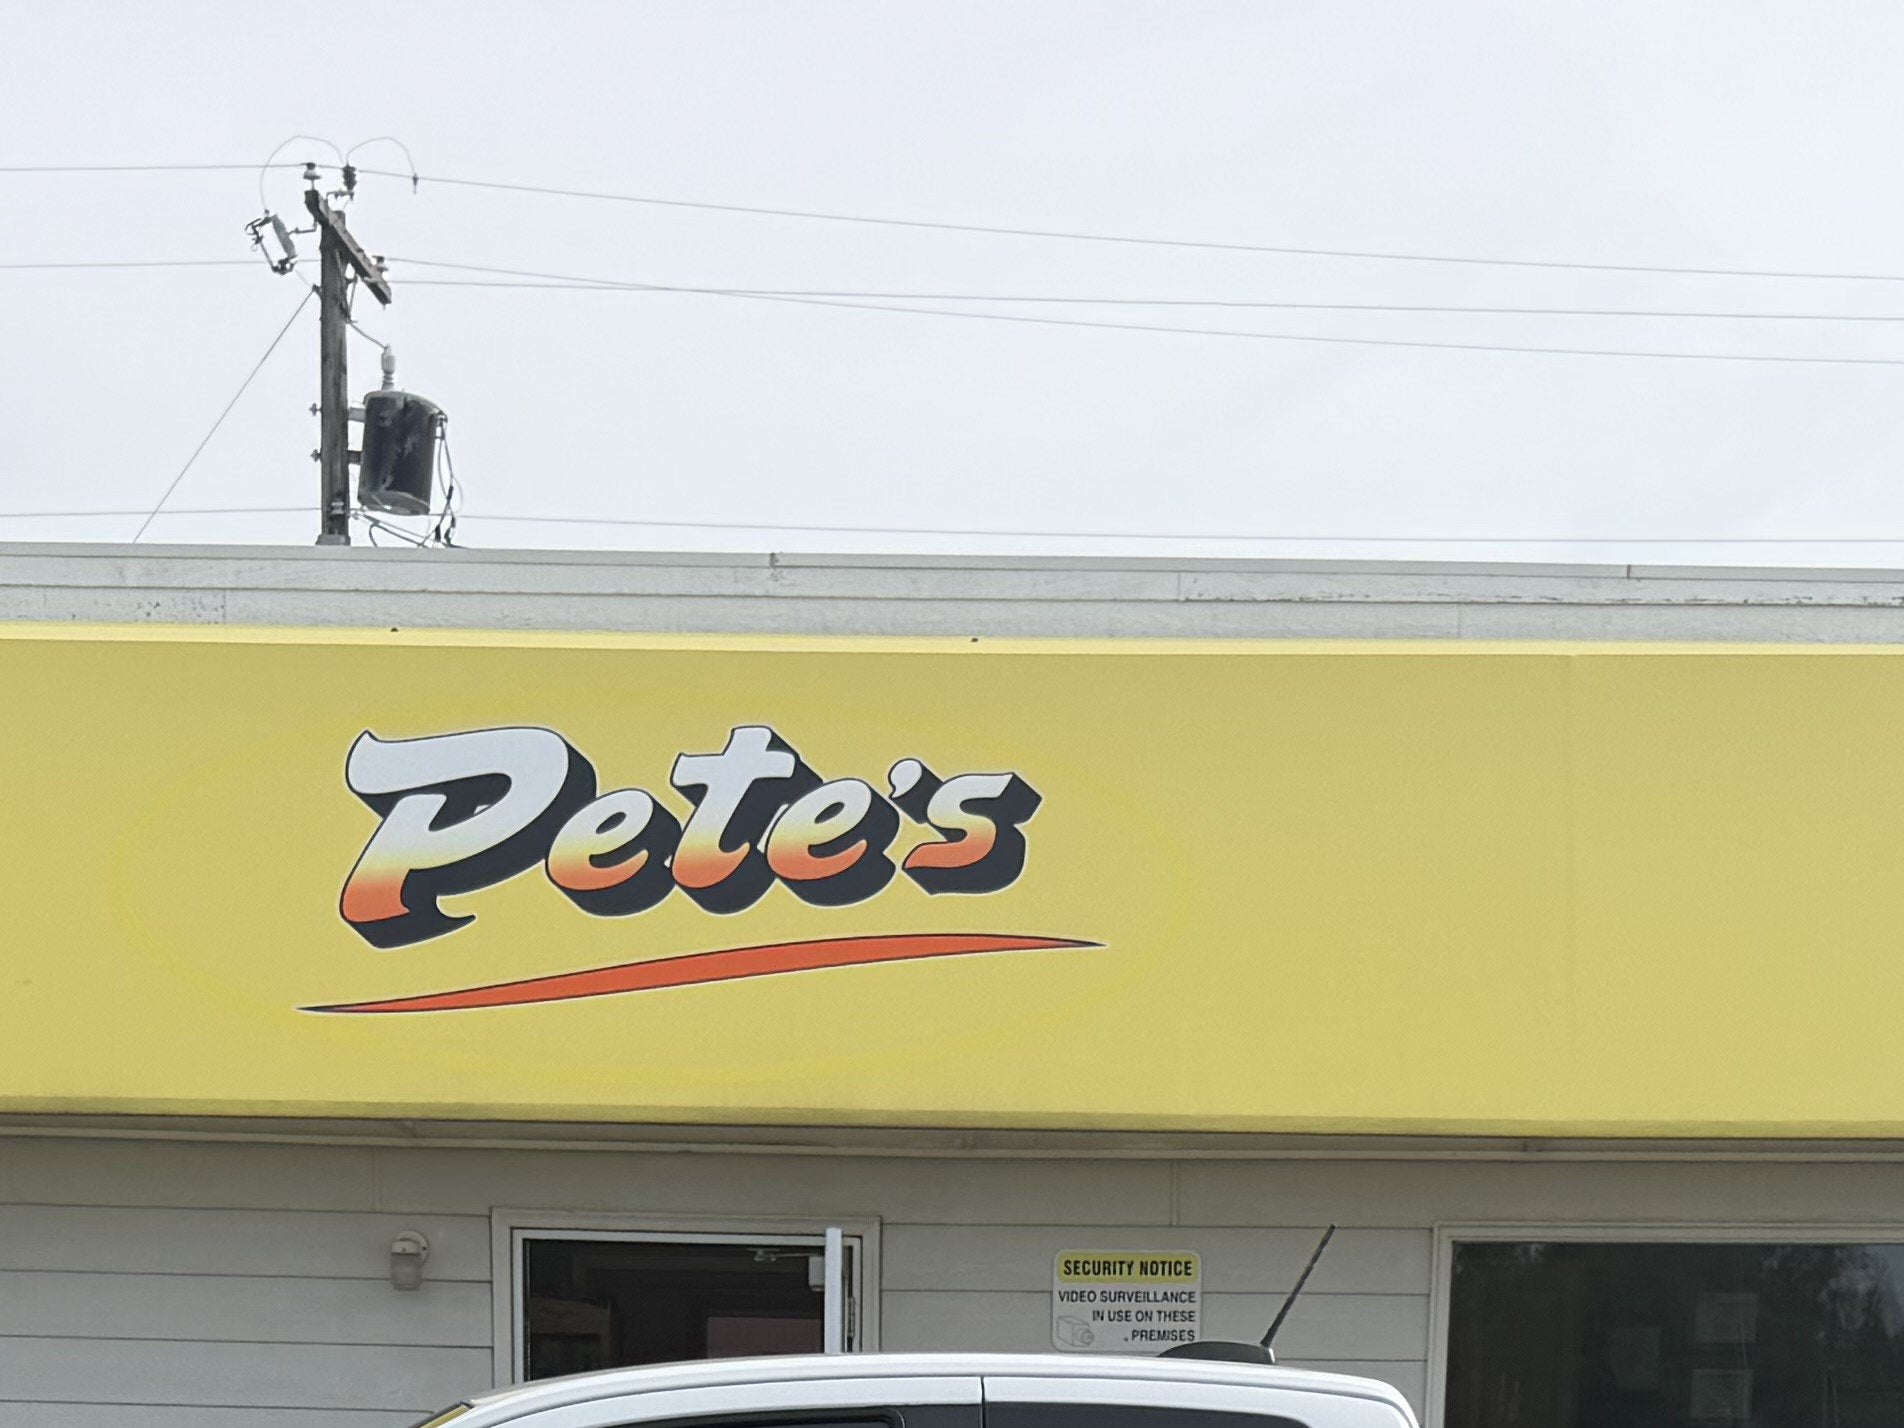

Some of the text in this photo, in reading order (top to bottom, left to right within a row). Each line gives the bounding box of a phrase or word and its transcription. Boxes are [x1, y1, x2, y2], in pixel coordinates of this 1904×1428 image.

[339, 726, 1043, 949] Pete's
[1063, 1260, 1192, 1276] SECURITY NOTICE
[1058, 1291, 1196, 1303] VIDEO SURVEILLANCE
[1092, 1310, 1196, 1322] IN USE ON THESE
[1131, 1330, 1195, 1342] PREMISES
